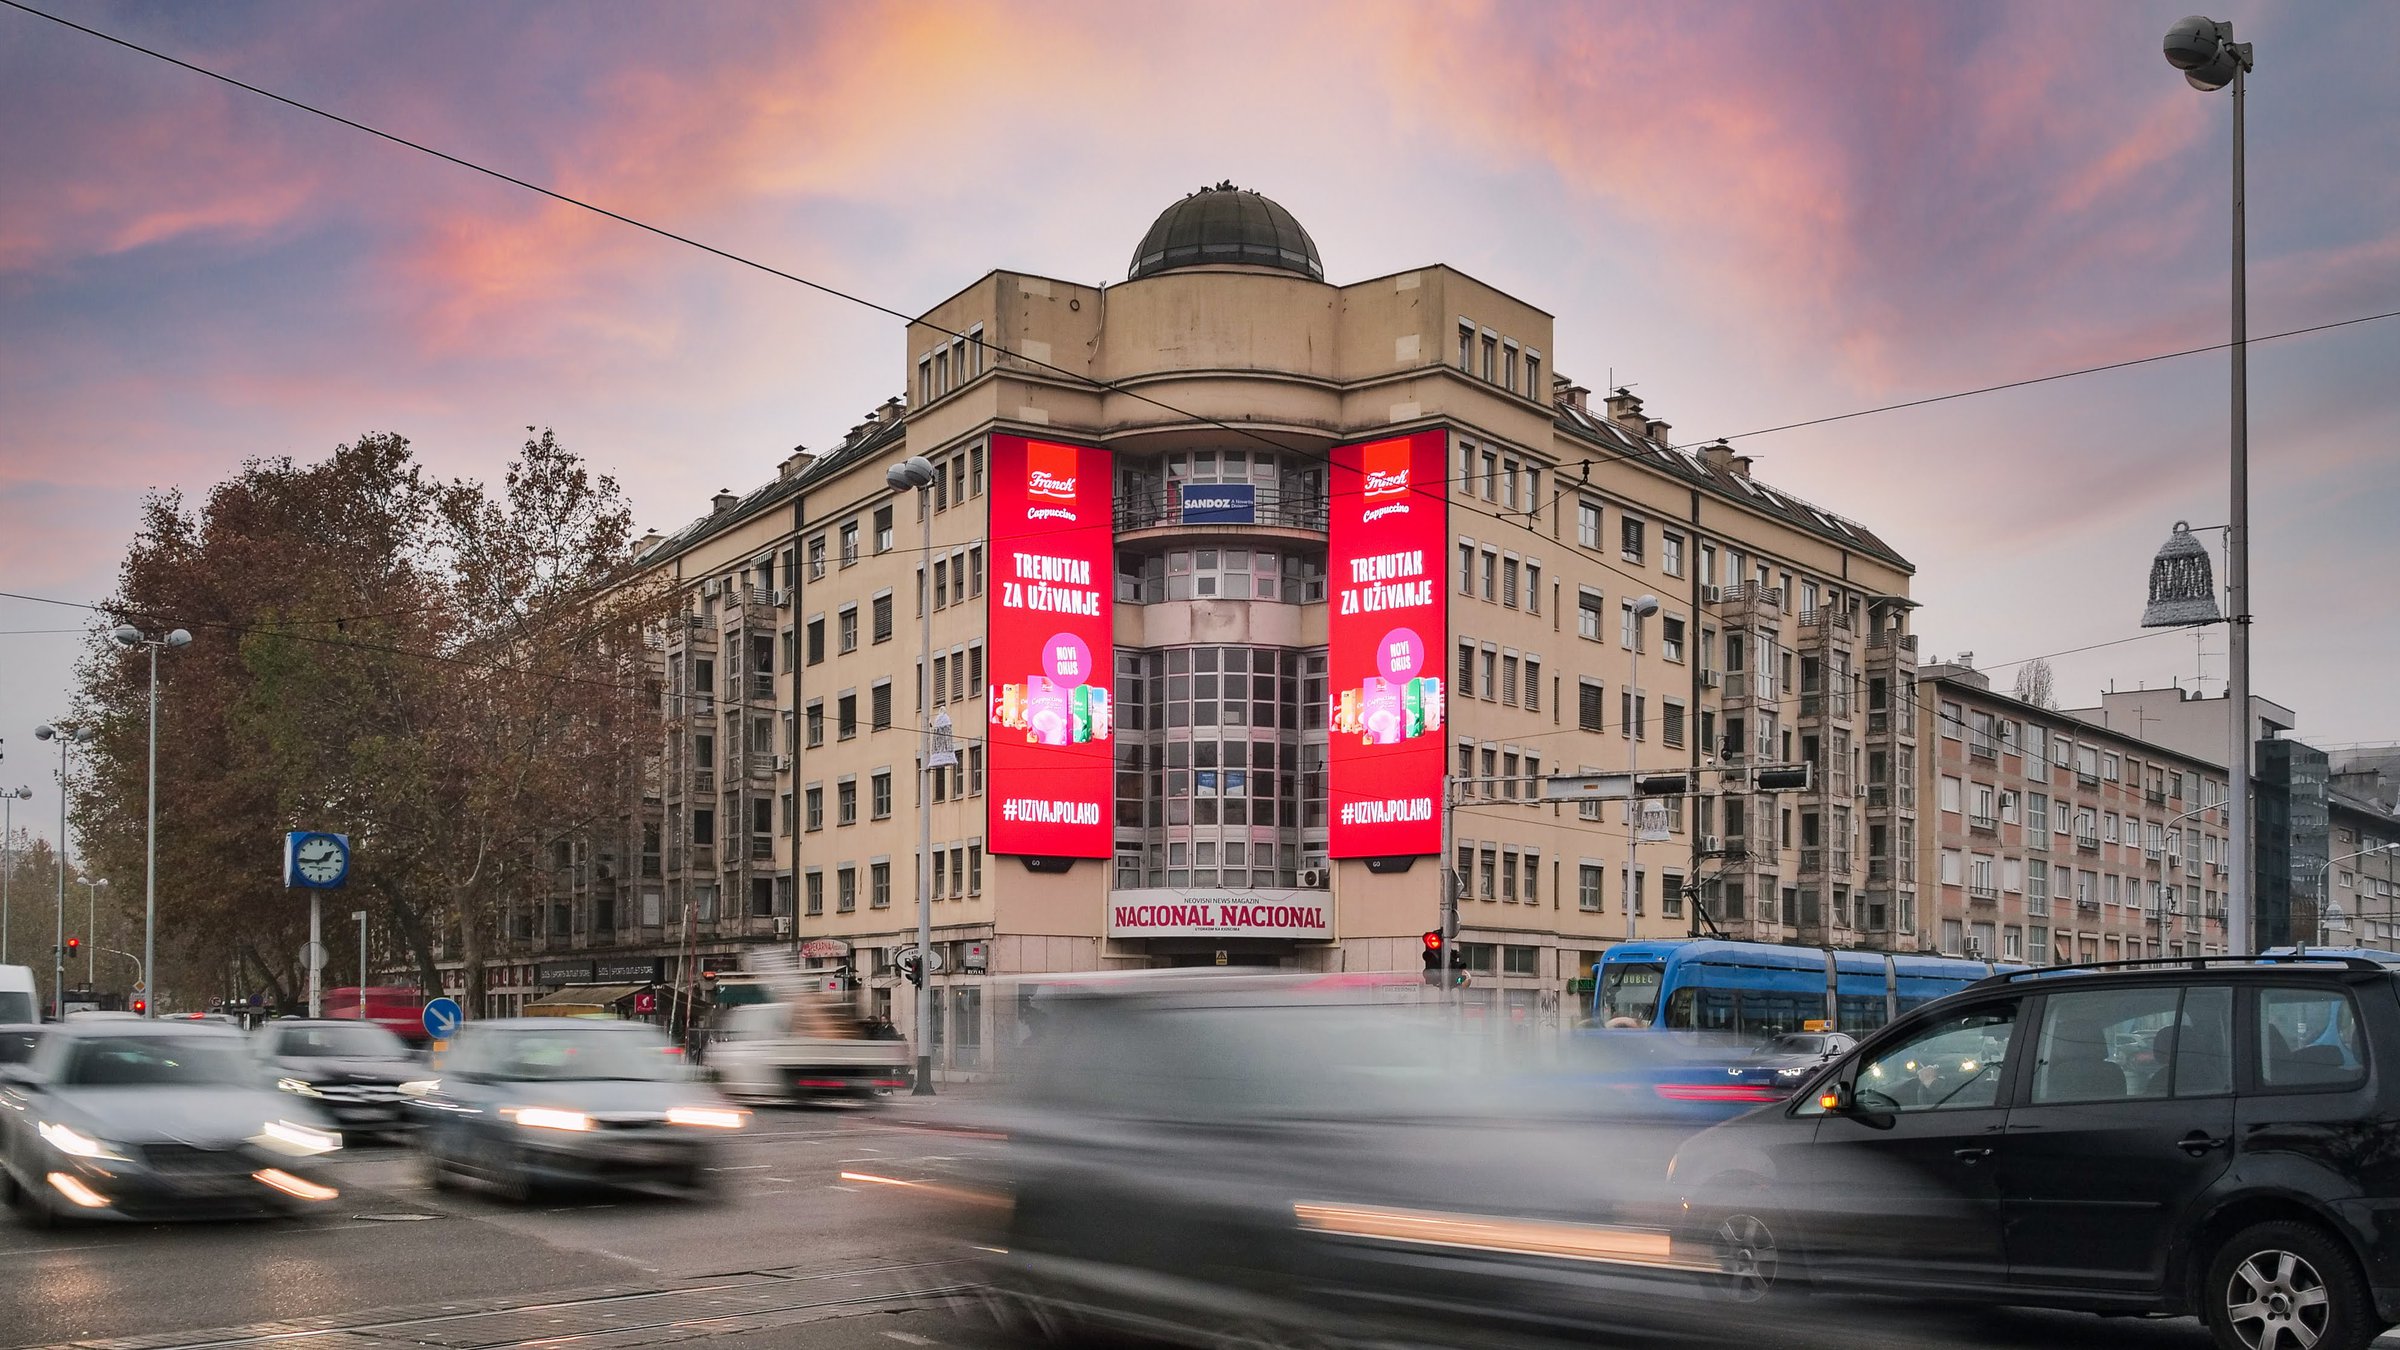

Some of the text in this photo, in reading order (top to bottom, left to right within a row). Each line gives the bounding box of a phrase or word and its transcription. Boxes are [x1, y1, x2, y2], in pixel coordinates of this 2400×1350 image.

[1029, 470, 1076, 493] Franck
[1364, 469, 1409, 491] Franck
[1027, 507, 1077, 522] Cappuccino
[1184, 499, 1231, 509] SANDOZ
[1363, 502, 1410, 523] Cappuccino
[1013, 552, 1090, 585] TRENUTAK
[1350, 550, 1423, 583] TRENUTAK
[1002, 582, 1023, 608] ZA
[1341, 589, 1359, 615] ZA
[1056, 661, 1079, 675] OKUS
[1390, 655, 1411, 673] OKUS
[1115, 905, 1326, 928] NACIONAL NACIONAL
[640, 965, 653, 974] STORE
[1623, 975, 1653, 984] DUBEC
